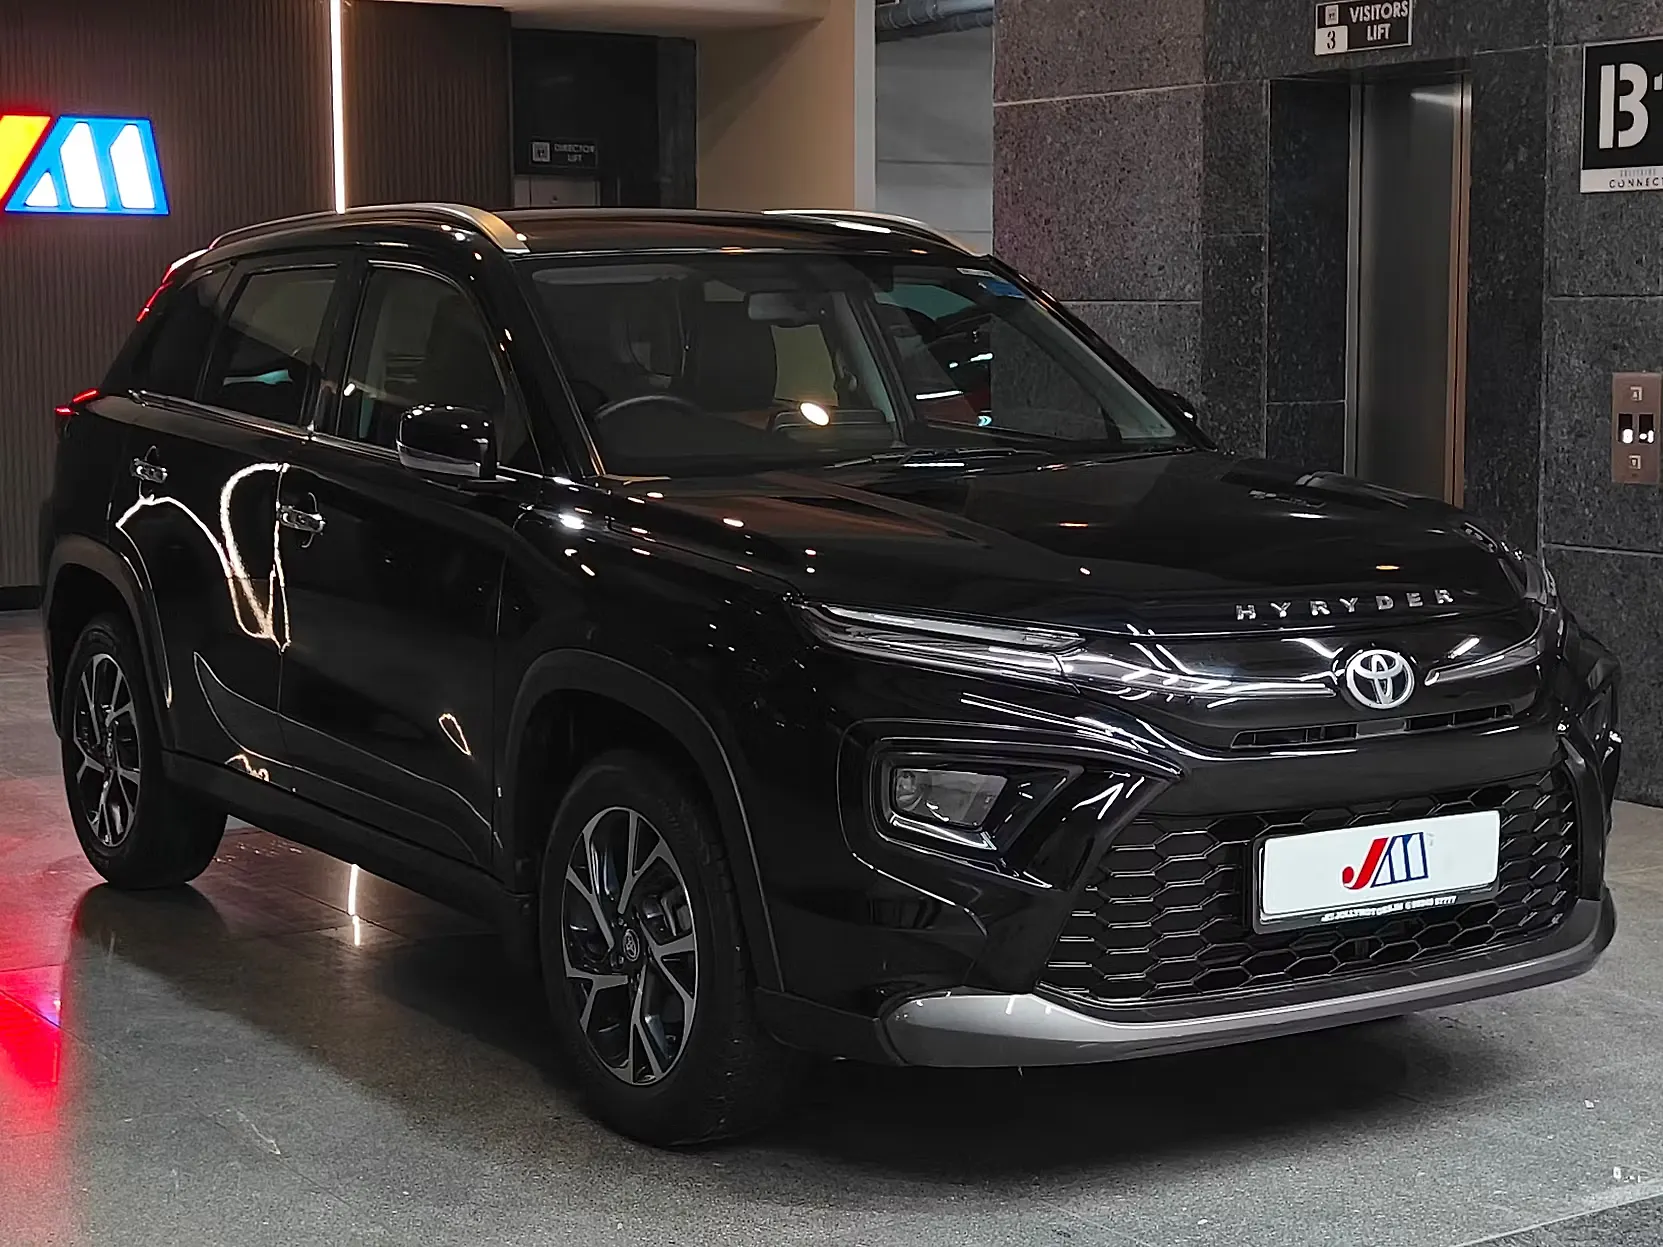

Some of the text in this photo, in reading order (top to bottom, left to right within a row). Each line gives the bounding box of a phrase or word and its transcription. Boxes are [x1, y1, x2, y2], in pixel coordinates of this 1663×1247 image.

[1349, 0, 1409, 23] VISITORS
[1326, 30, 1336, 50] 3
[1366, 23, 1391, 41] LIFT
[1598, 62, 1663, 150] B
[1609, 176, 1663, 188] CONNEC
[1236, 589, 1454, 620] HYRYDER
